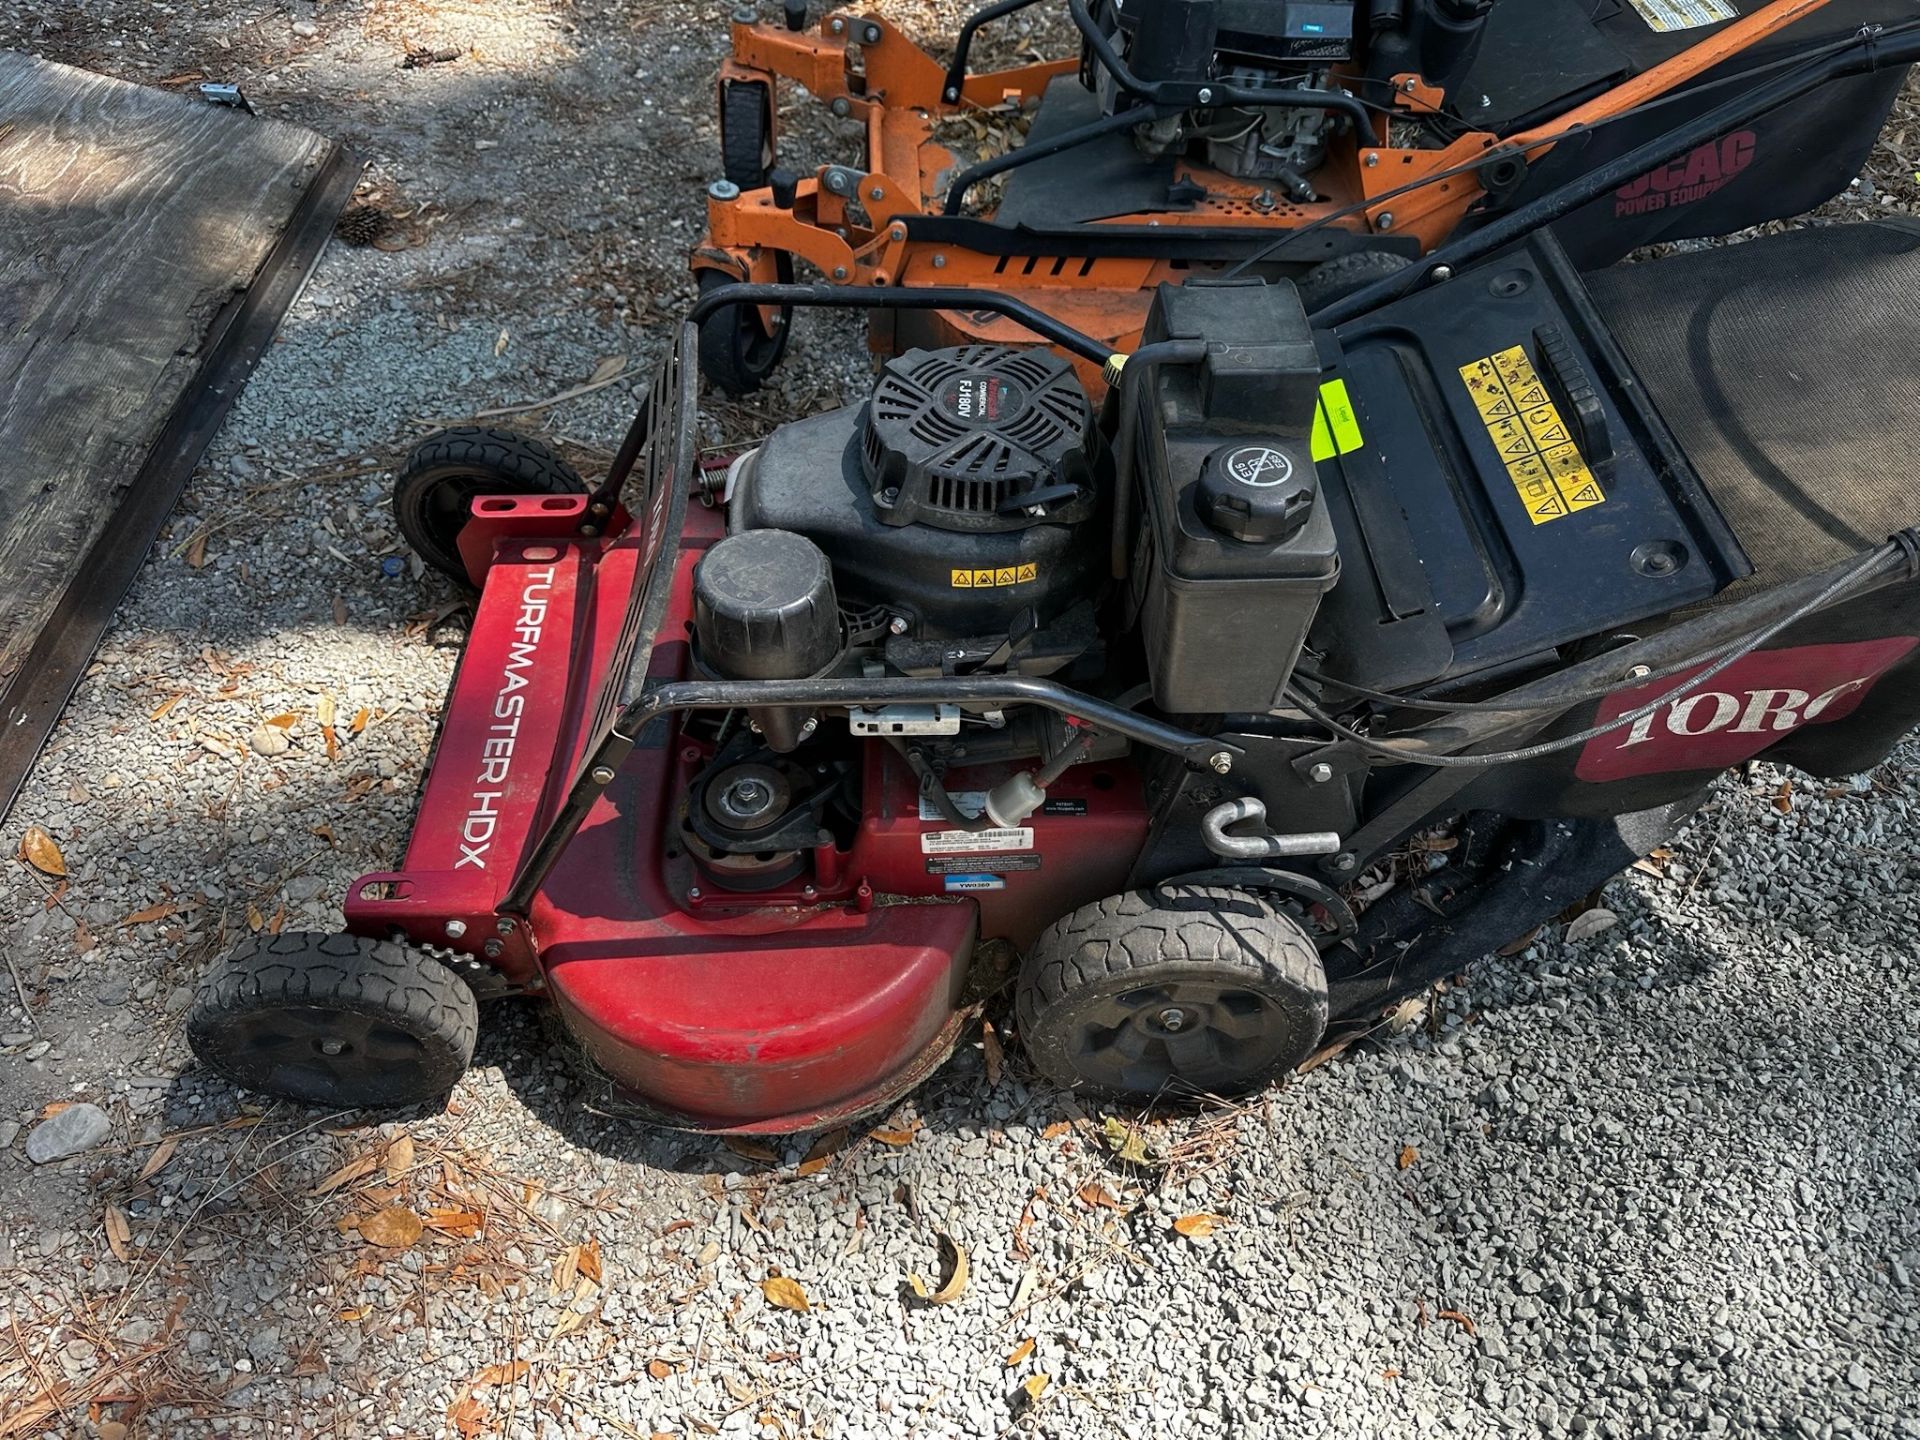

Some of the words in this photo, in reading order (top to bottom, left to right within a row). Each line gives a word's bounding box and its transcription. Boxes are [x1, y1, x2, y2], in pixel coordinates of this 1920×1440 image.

[1615, 190, 1666, 218] POWER
[958, 379, 972, 418] FJ180V
[1234, 462, 1252, 478] E15
[1269, 454, 1286, 469] E85
[477, 567, 555, 783] TURFMASTER
[454, 792, 503, 870] HDX
